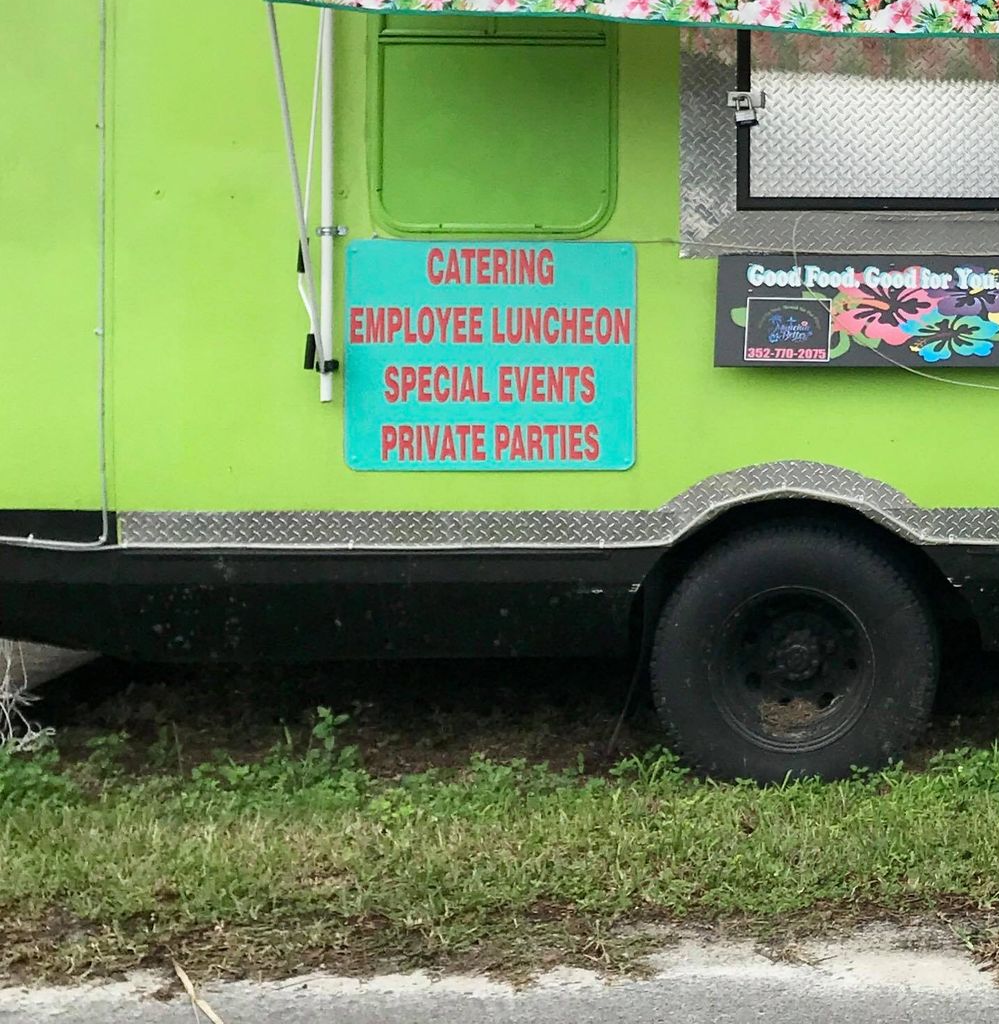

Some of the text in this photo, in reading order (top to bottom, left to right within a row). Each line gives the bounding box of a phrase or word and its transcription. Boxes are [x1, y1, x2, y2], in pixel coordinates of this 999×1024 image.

[427, 247, 555, 285] CATERING
[747, 264, 801, 287] Good
[863, 264, 917, 289] Good
[920, 267, 952, 289] for
[350, 306, 631, 344] EMPLOYEE LUNCHEON
[747, 347, 827, 360] 352-770-2075
[384, 365, 596, 403] SPECIAL EVENTS
[381, 423, 600, 462] PRIVATE PARTIES
